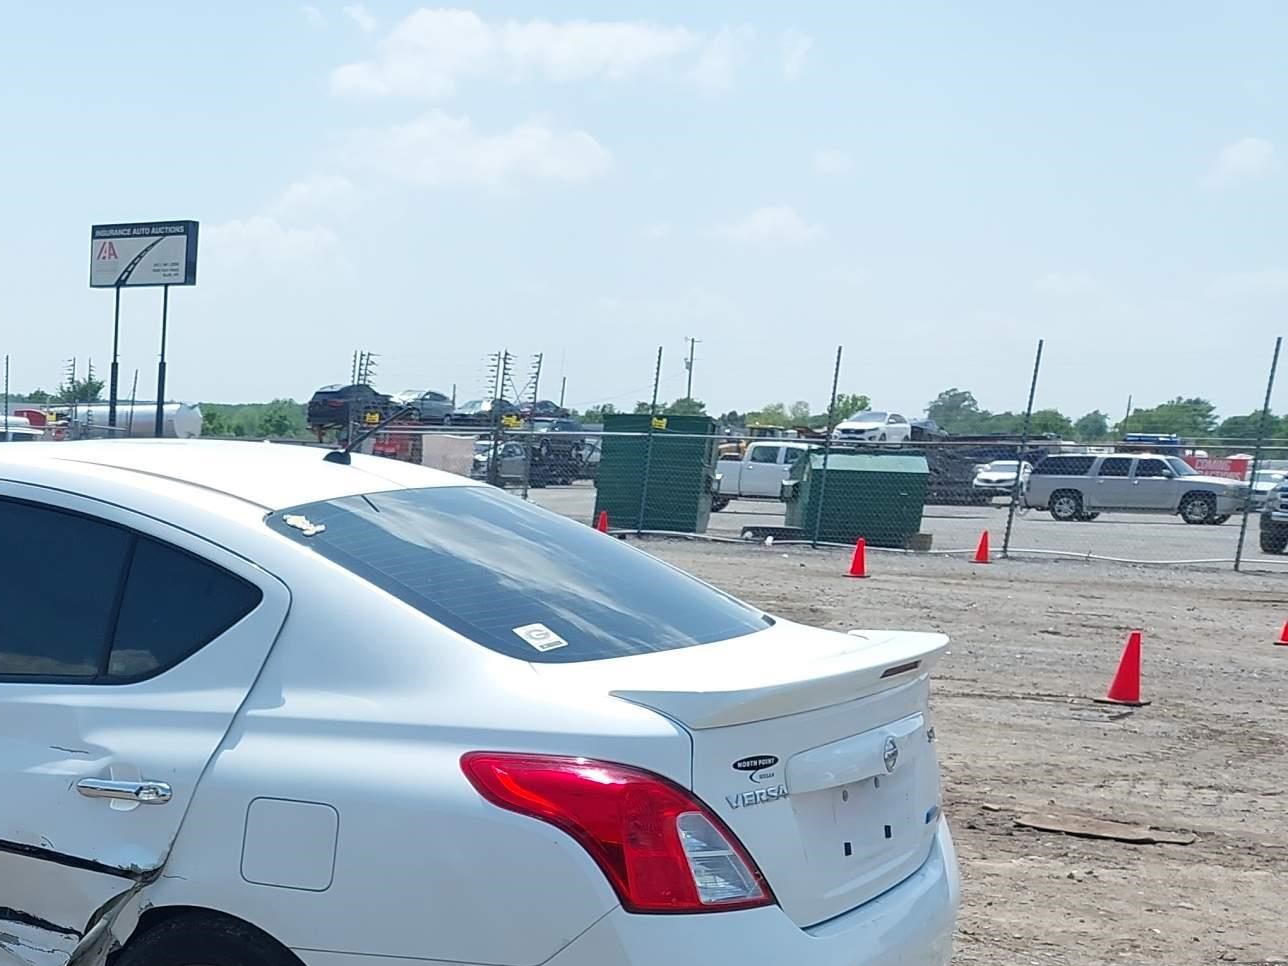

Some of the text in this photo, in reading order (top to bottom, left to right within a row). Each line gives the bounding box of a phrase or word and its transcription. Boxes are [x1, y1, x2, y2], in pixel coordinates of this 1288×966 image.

[95, 225, 185, 238] INSURANCE AUTO AUCTIONS
[737, 757, 775, 768] NORTH POINT
[725, 784, 788, 810] VERSA
